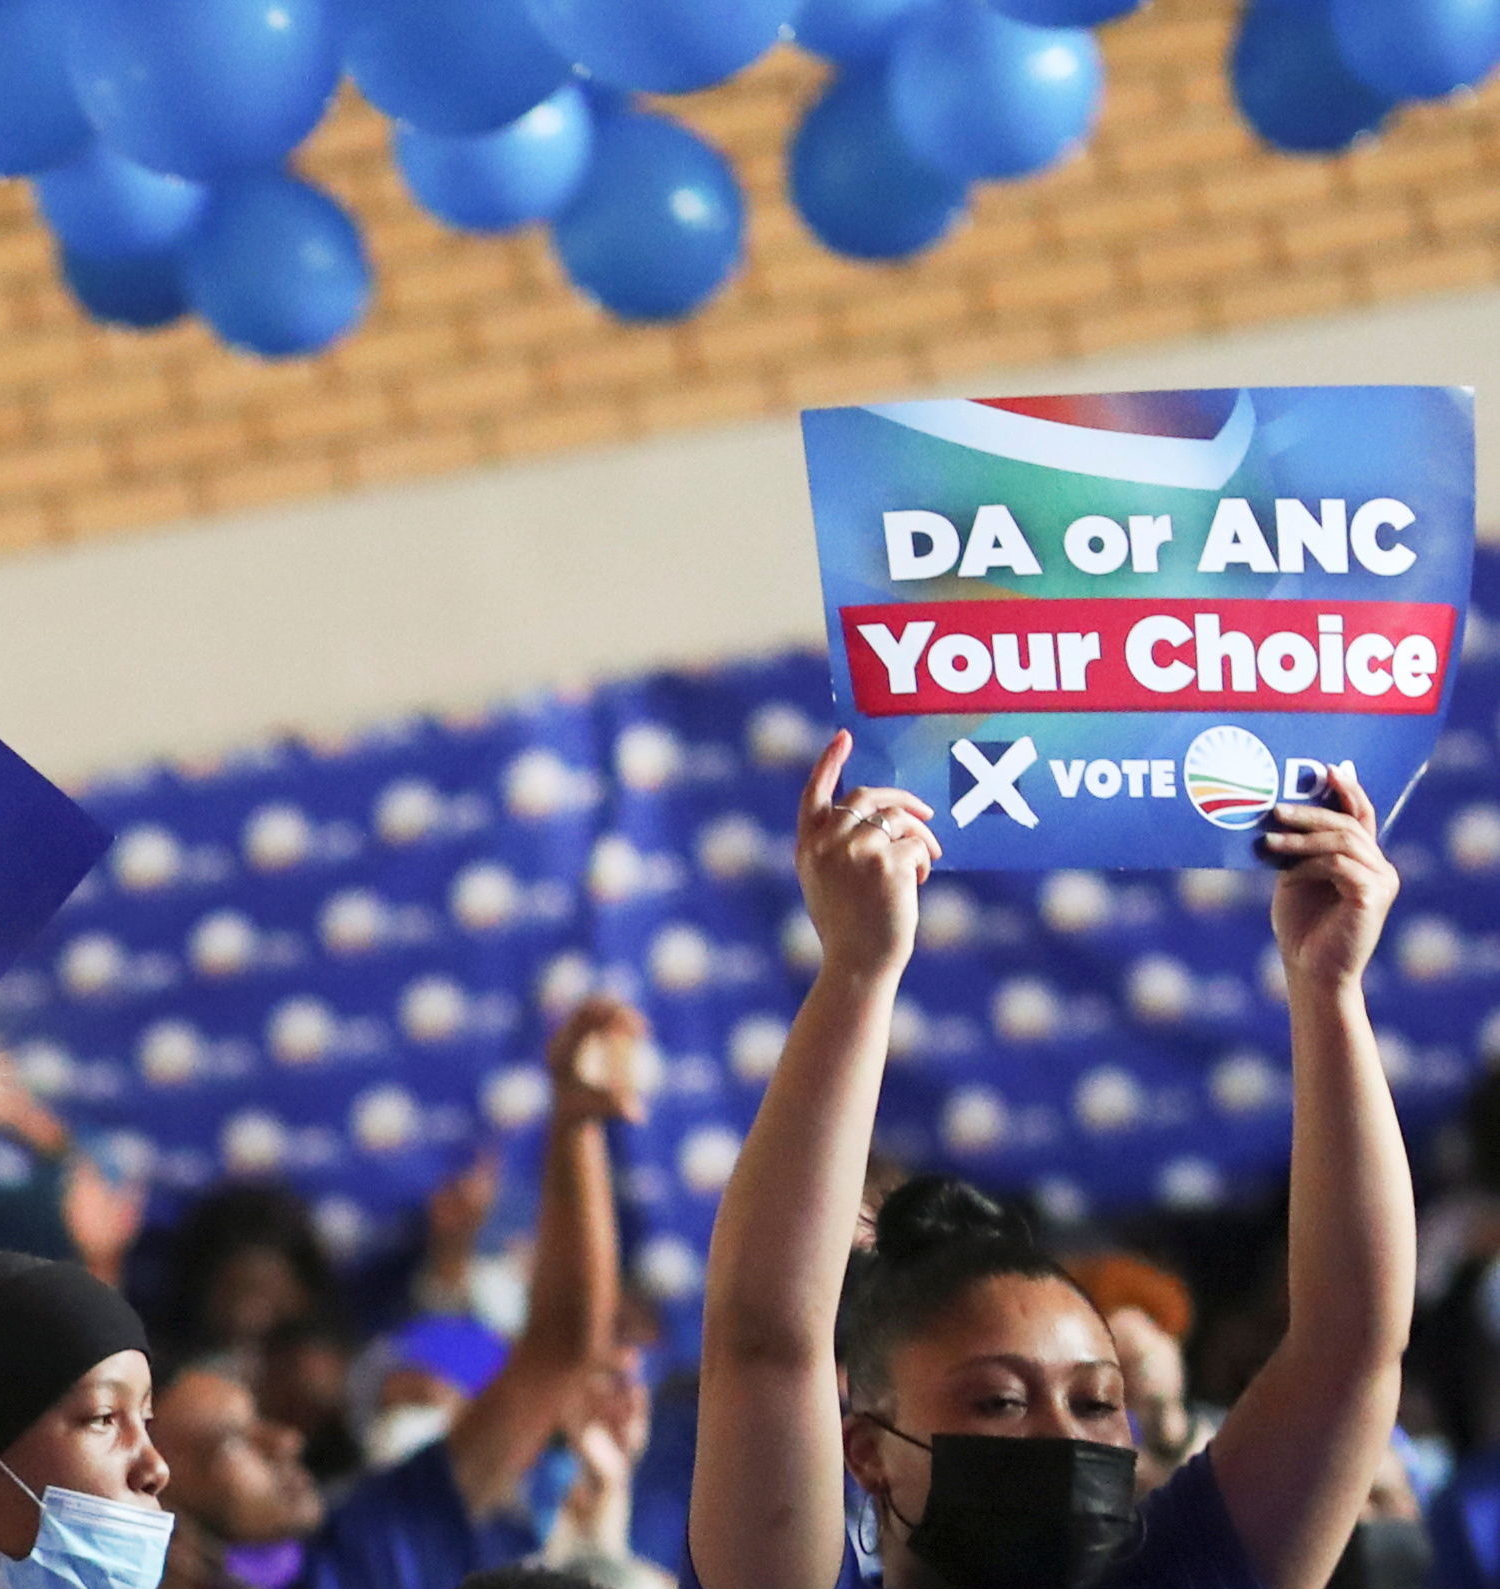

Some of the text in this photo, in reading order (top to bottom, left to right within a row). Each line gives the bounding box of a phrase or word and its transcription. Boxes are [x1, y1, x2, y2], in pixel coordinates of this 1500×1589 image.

[883, 497, 1417, 581] DA or ANC
[856, 613, 1438, 697] Your Choice
[1048, 759, 1177, 800] VOTE
